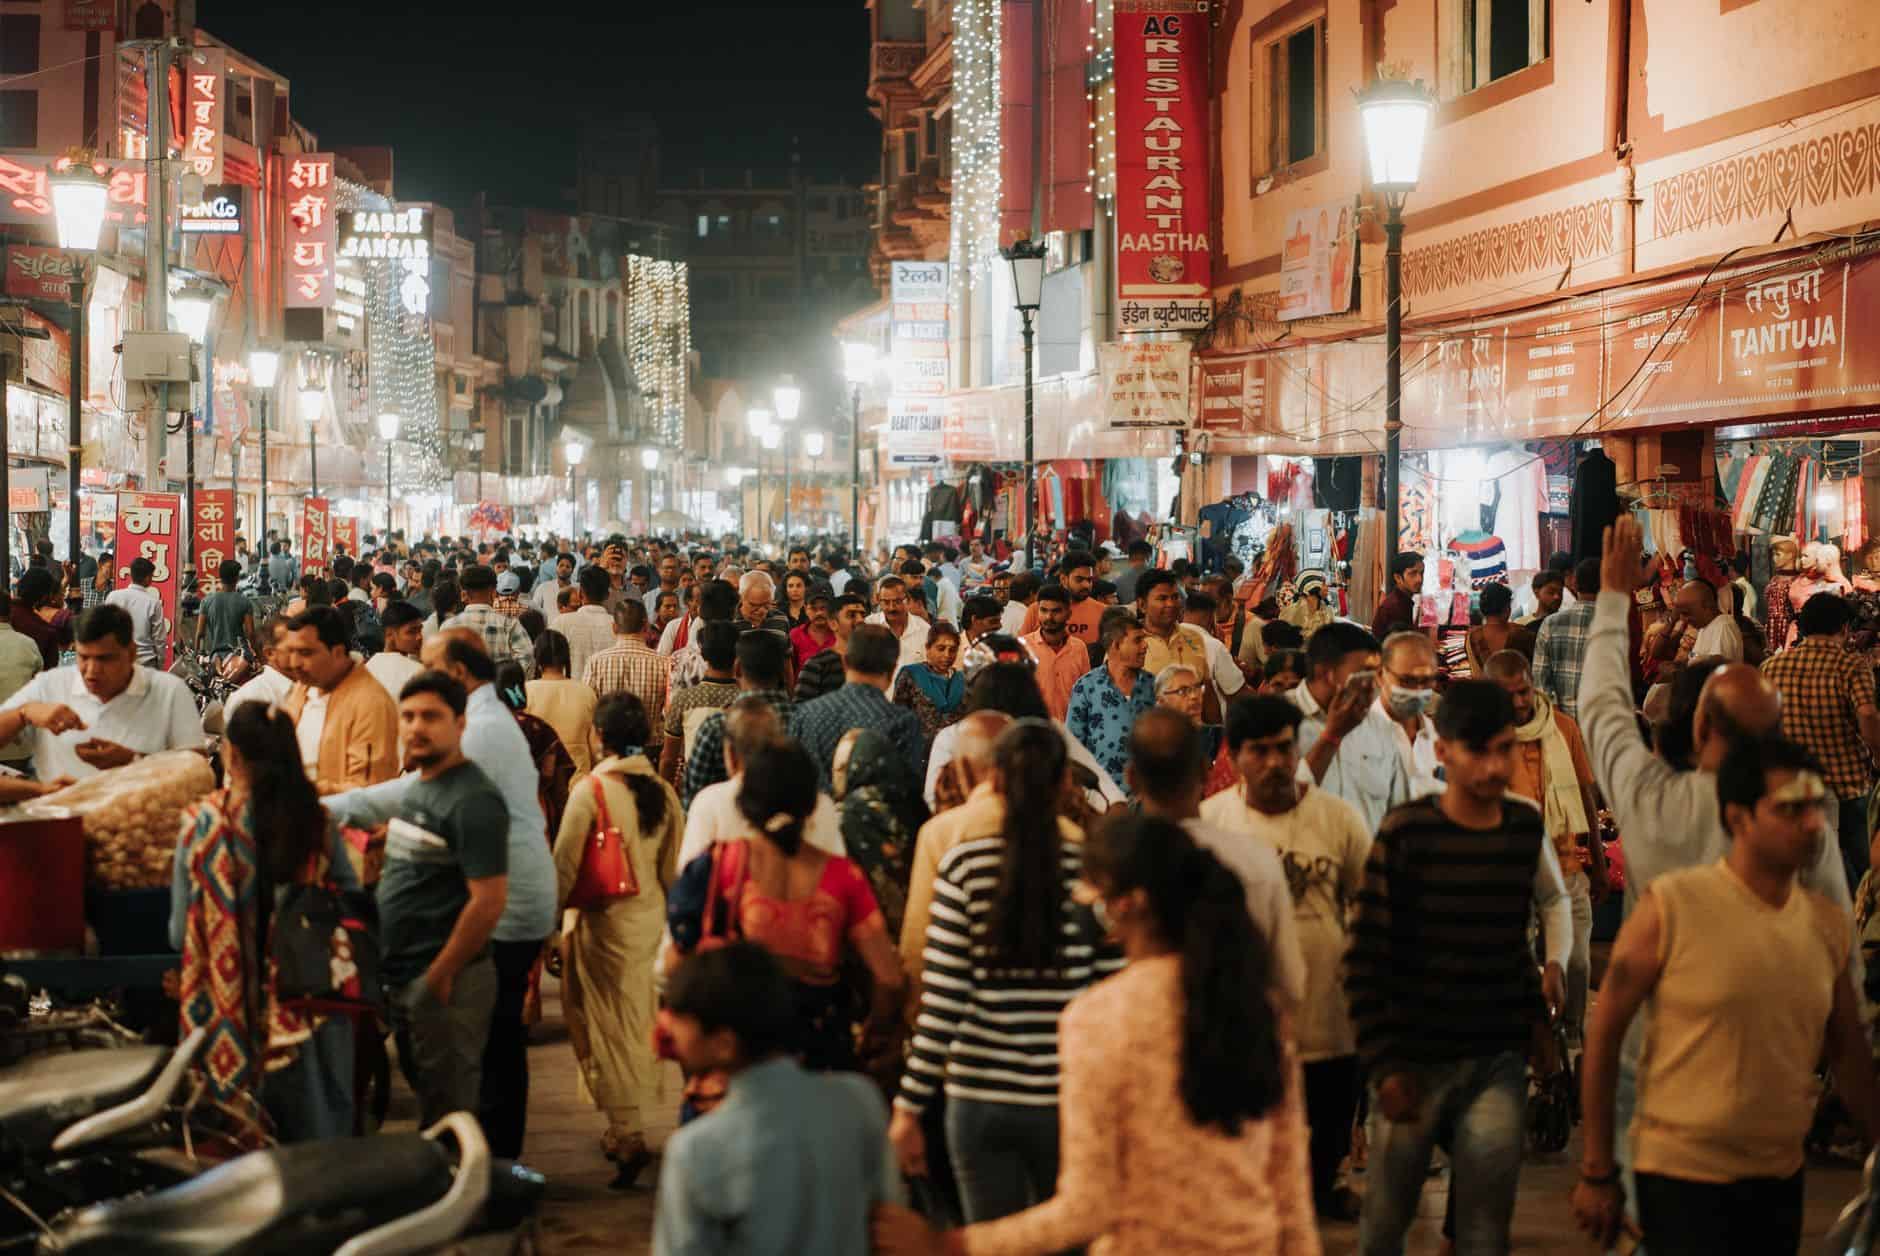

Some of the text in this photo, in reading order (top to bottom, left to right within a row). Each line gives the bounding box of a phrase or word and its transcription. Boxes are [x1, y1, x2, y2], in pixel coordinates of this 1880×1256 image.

[1144, 16, 1180, 36] AC
[1143, 38, 1184, 229] RESTAURANT
[1120, 233, 1209, 252] AASTHA
[1731, 315, 1837, 360] TANTUJA
